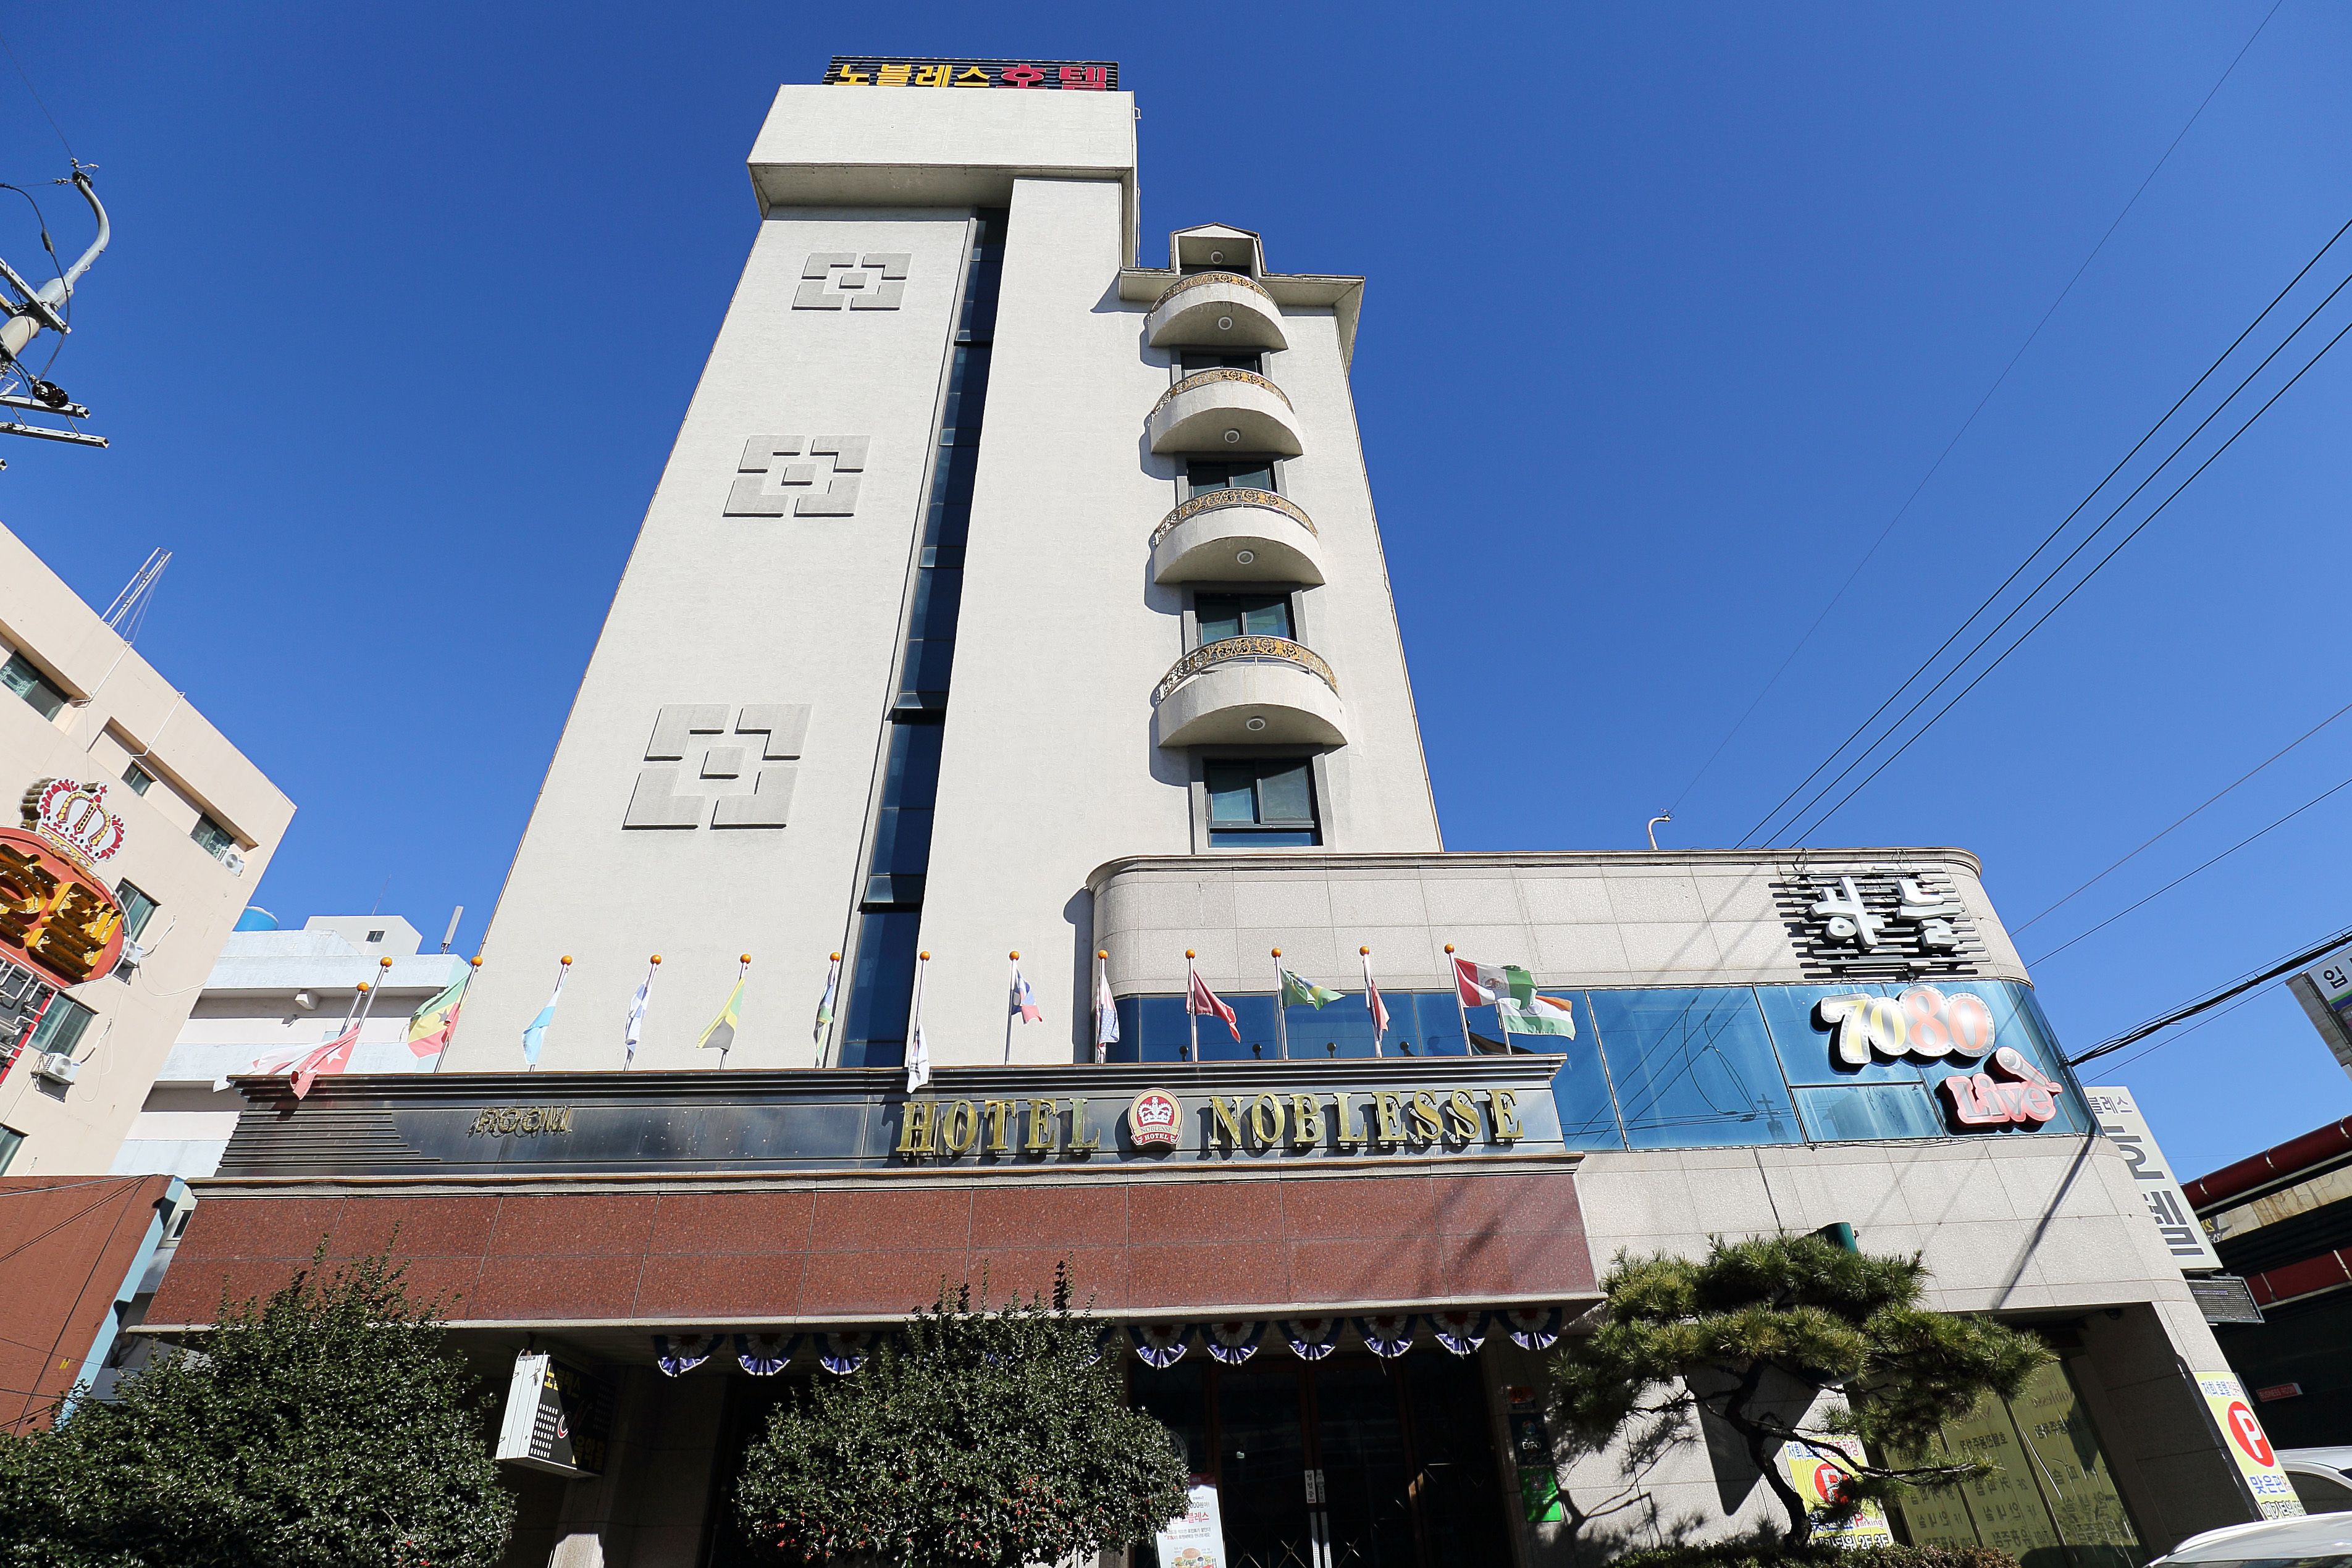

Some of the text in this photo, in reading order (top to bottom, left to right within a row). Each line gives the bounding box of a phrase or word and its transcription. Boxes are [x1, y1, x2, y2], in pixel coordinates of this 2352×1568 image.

[1824, 988, 1991, 1060] 7080
[1952, 1075, 2053, 1120] Live
[896, 1088, 1524, 1152] HOTEL NOBLESSE
[1141, 1125, 1172, 1133] NOBLESSE
[2201, 1381, 2219, 1396] 저희
[2233, 1410, 2263, 1459] P
[1522, 1441, 1542, 1450] EXPO
[1786, 1443, 1804, 1458] 저희
[2249, 1475, 2286, 1495] 맞은편
[1853, 1511, 1883, 1528] Parking
[1857, 1535, 1873, 1550] 2F
[1873, 1533, 1888, 1548] 3F
